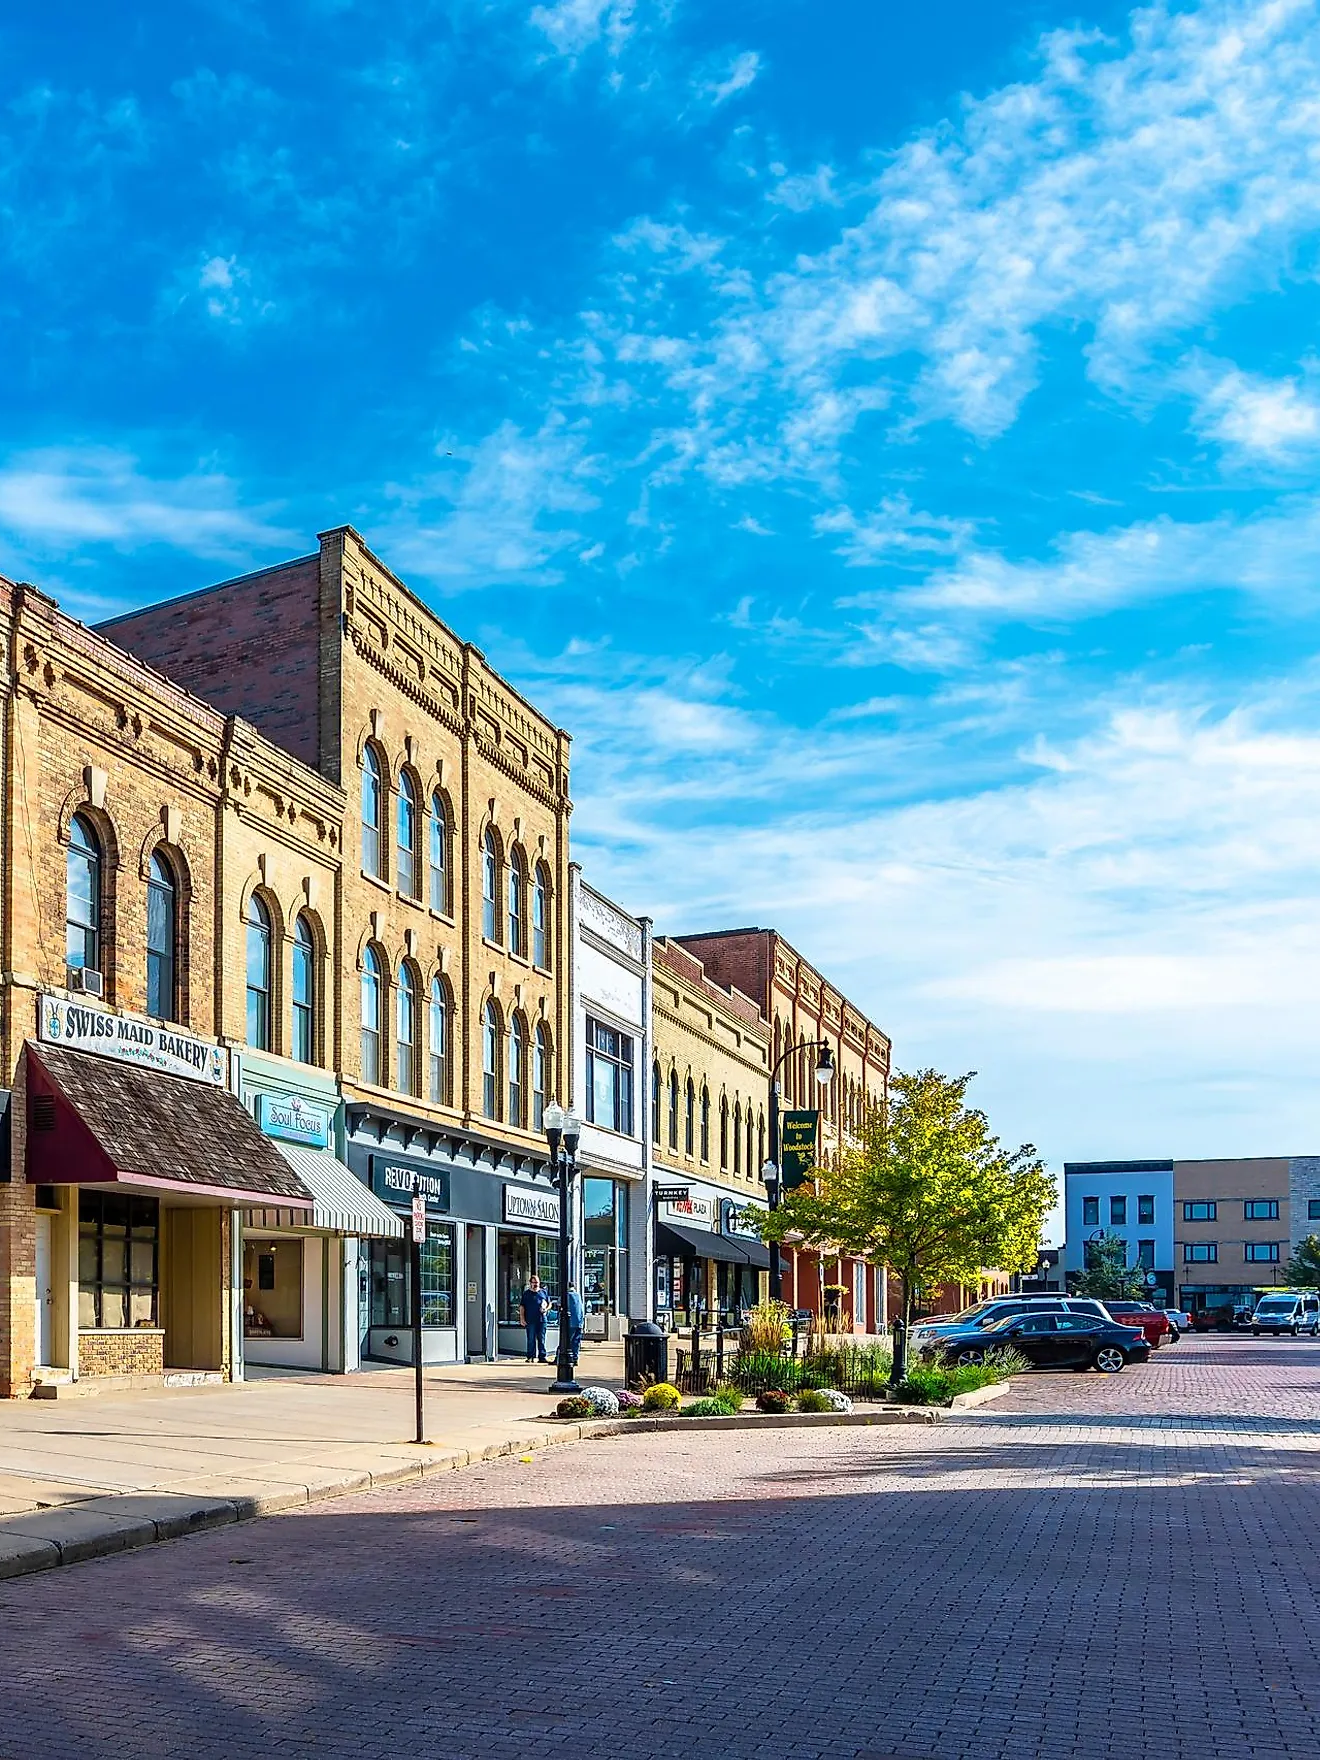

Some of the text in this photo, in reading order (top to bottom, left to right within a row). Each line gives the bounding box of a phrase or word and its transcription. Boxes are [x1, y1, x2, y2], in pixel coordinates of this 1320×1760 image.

[66, 1006, 209, 1072] SWISS MAID BAKERY
[270, 1106, 322, 1133] Soul Focus
[786, 1121, 813, 1130] Welcome
[783, 1142, 815, 1152] Woodstock
[384, 1166, 441, 1196] REVOUTION
[537, 1199, 560, 1220] SALON
